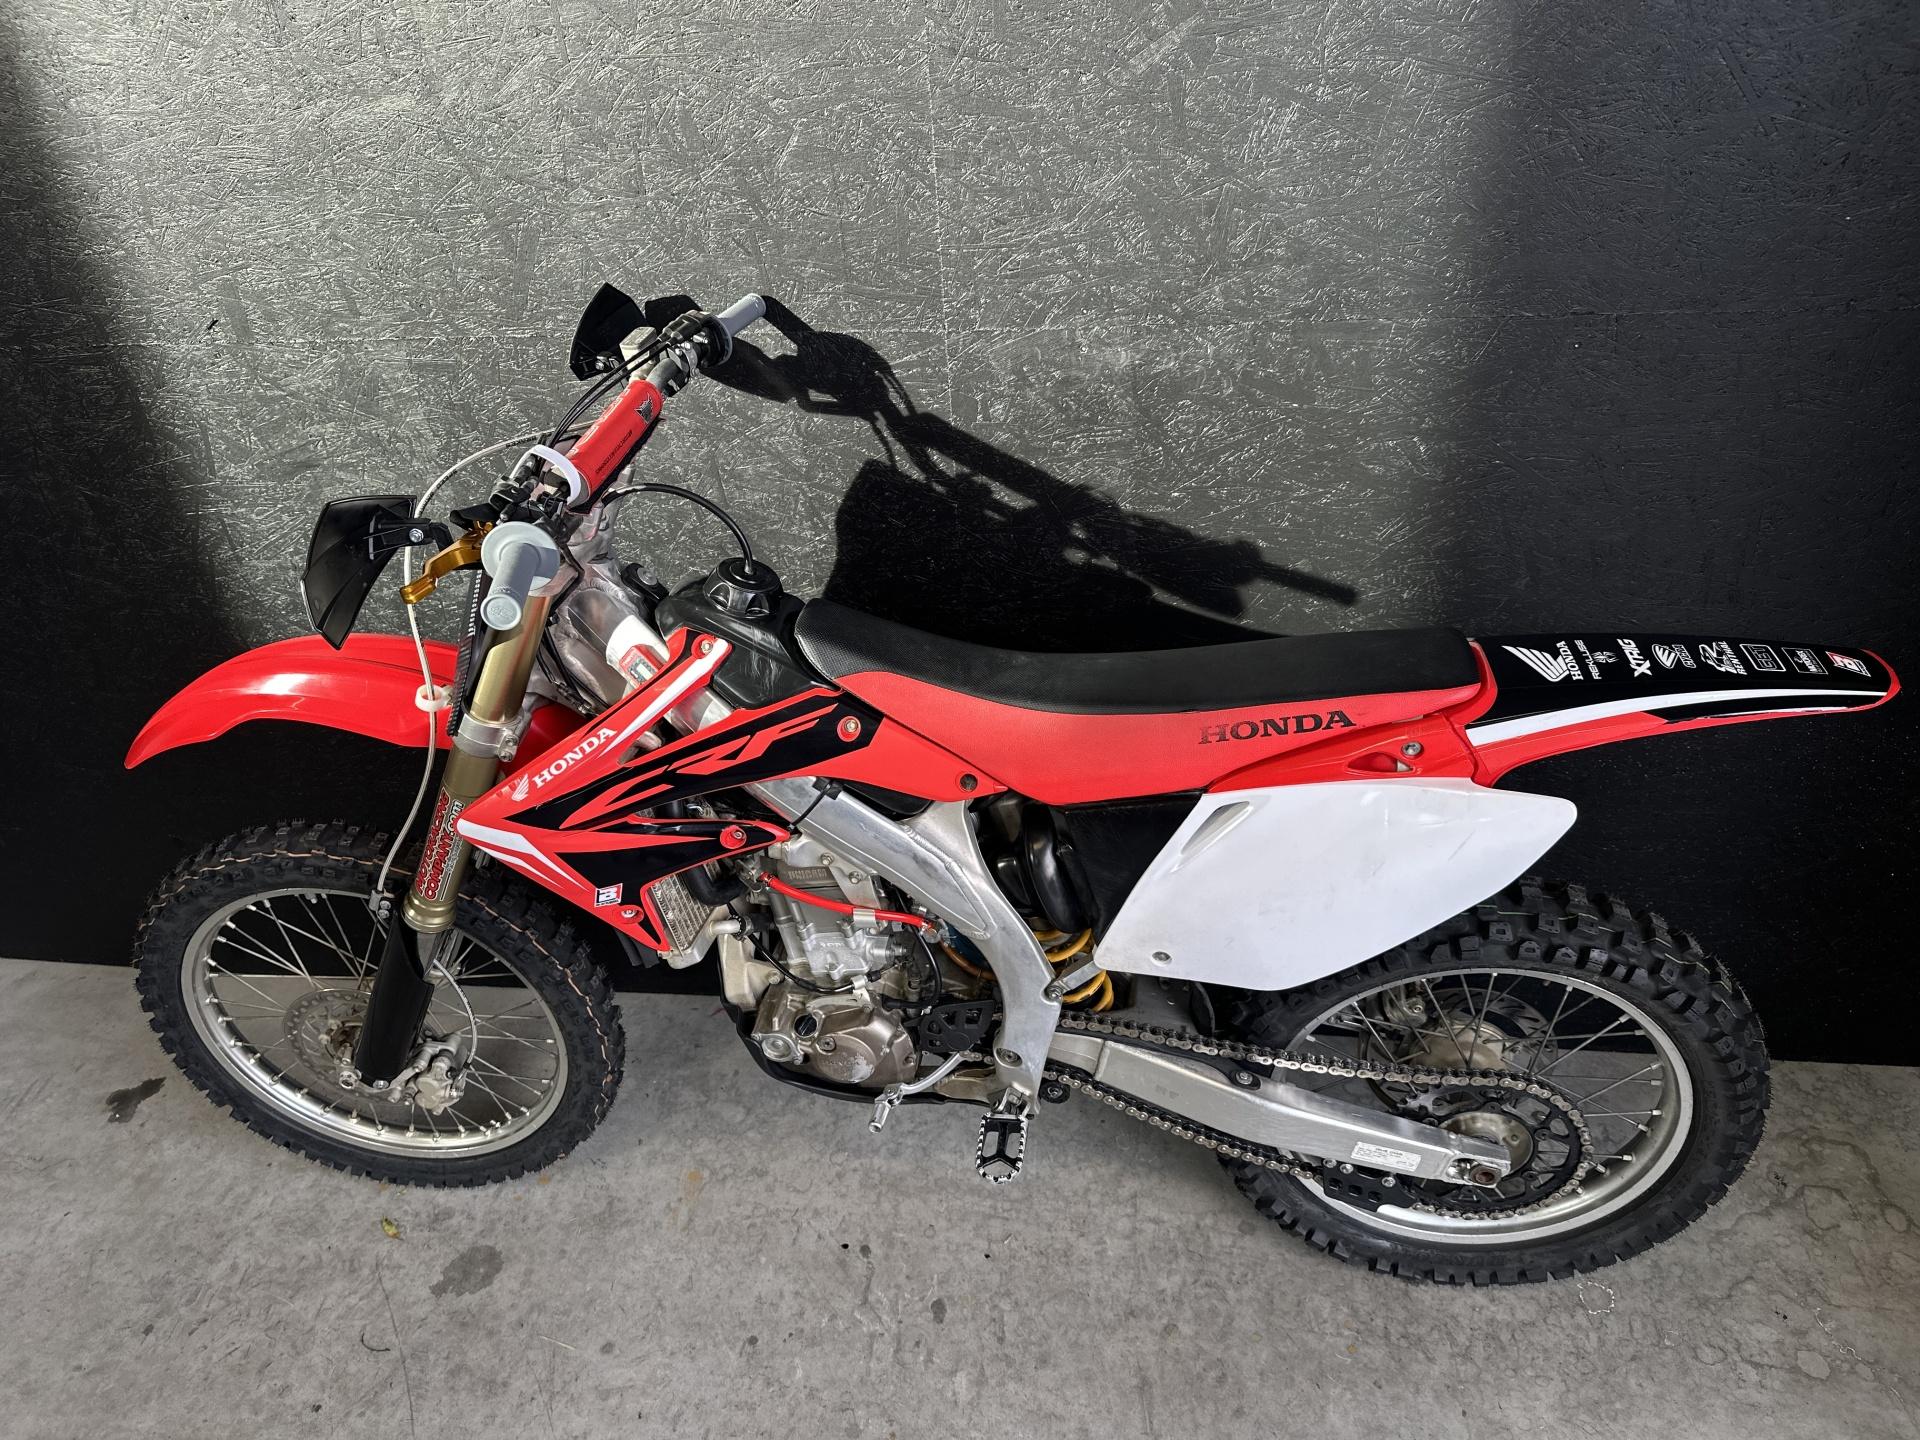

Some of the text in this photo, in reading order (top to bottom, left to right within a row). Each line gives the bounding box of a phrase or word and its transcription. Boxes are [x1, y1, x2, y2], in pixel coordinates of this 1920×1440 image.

[1556, 640, 1584, 681] HONDA
[1574, 639, 1602, 680] REKLUSE
[1616, 638, 1653, 678] XTRIG
[1717, 641, 1748, 675] RENTHAL
[1197, 710, 1357, 745] HONDA
[532, 727, 618, 789] HONDA
[415, 787, 450, 896] MOTORACING
